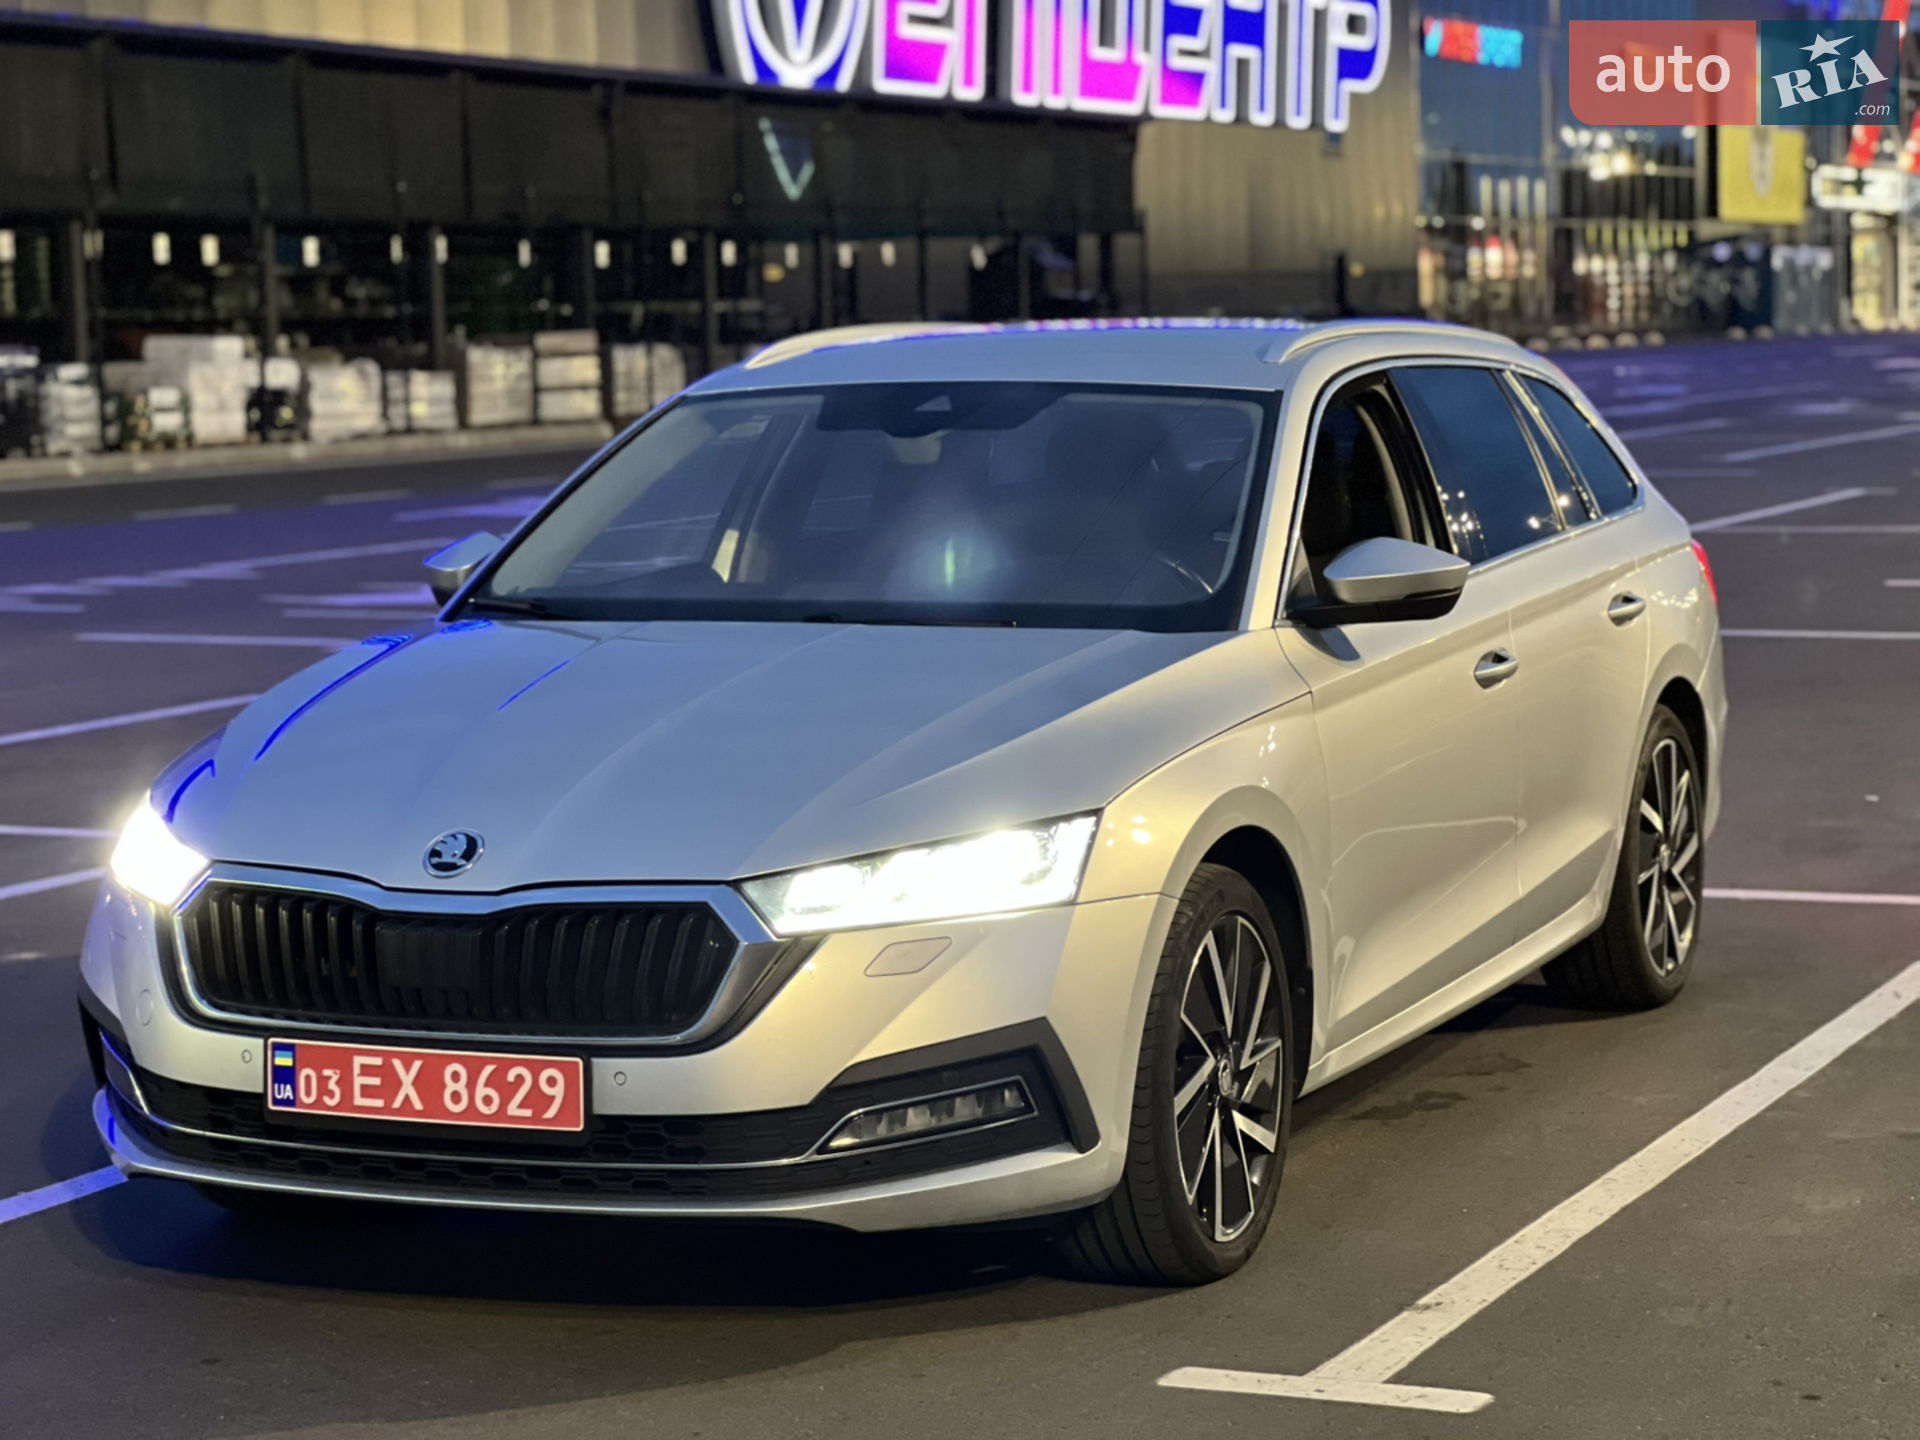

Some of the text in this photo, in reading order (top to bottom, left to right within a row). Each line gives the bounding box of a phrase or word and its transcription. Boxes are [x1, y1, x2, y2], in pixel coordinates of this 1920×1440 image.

[273, 1083, 294, 1101] UA
[299, 1055, 565, 1119] 03 EX 8629
